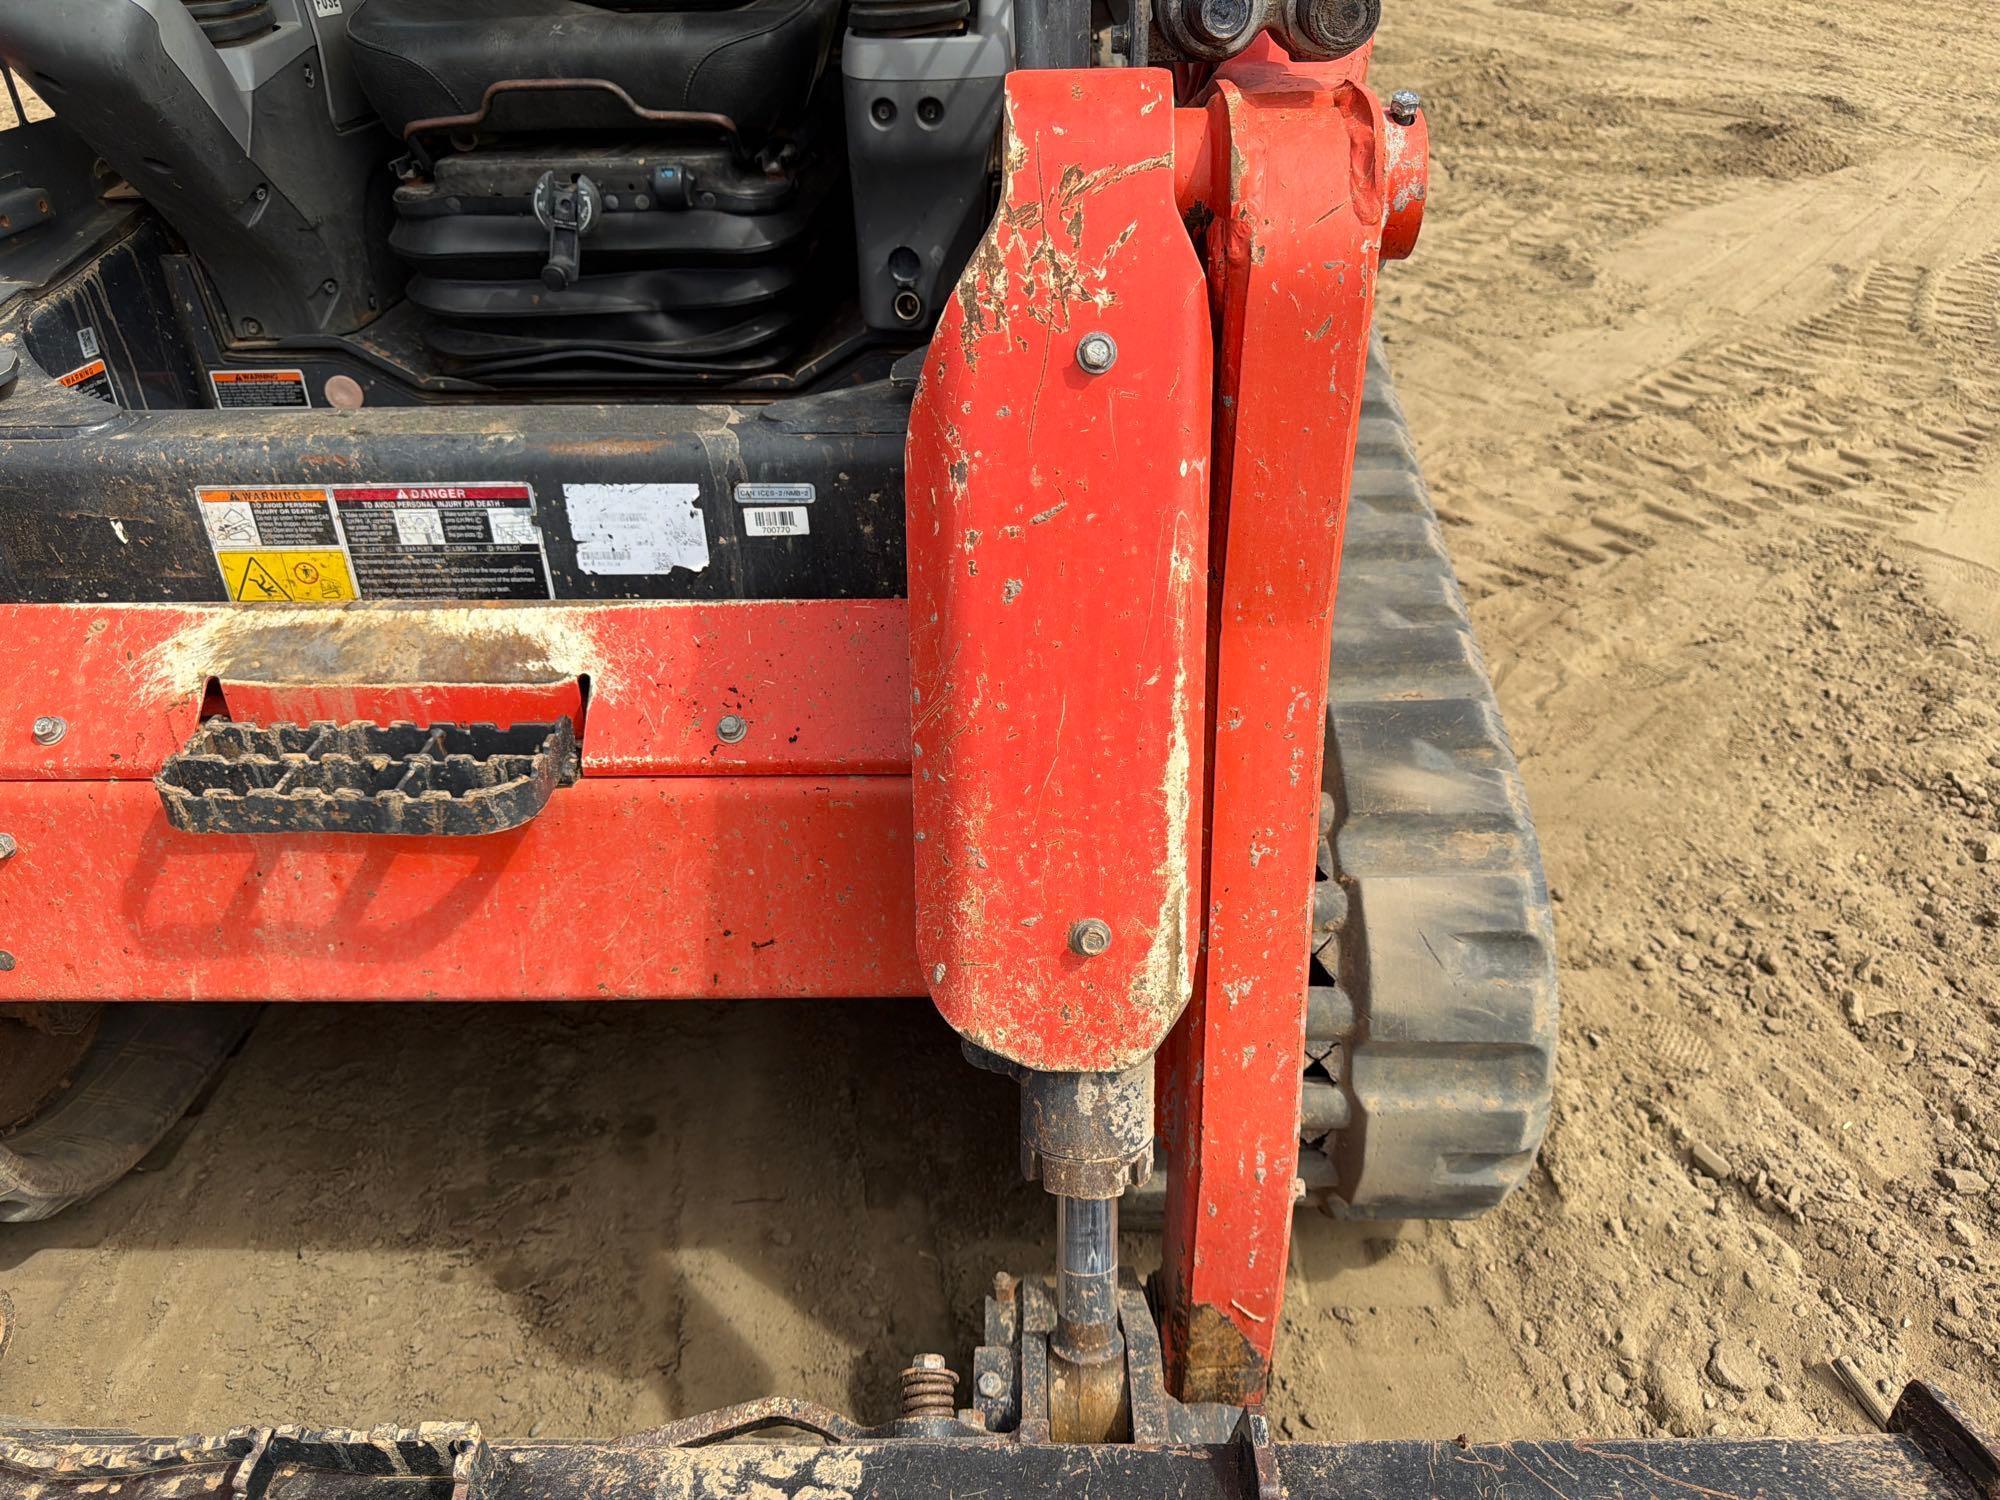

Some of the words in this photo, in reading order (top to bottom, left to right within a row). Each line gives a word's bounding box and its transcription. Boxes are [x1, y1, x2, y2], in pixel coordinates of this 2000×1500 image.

[66, 367, 94, 385] WARNING
[241, 491, 302, 500] WARNING
[411, 488, 467, 499] DANGER
[437, 500, 463, 508] INJURY
[762, 526, 791, 534] 700770
